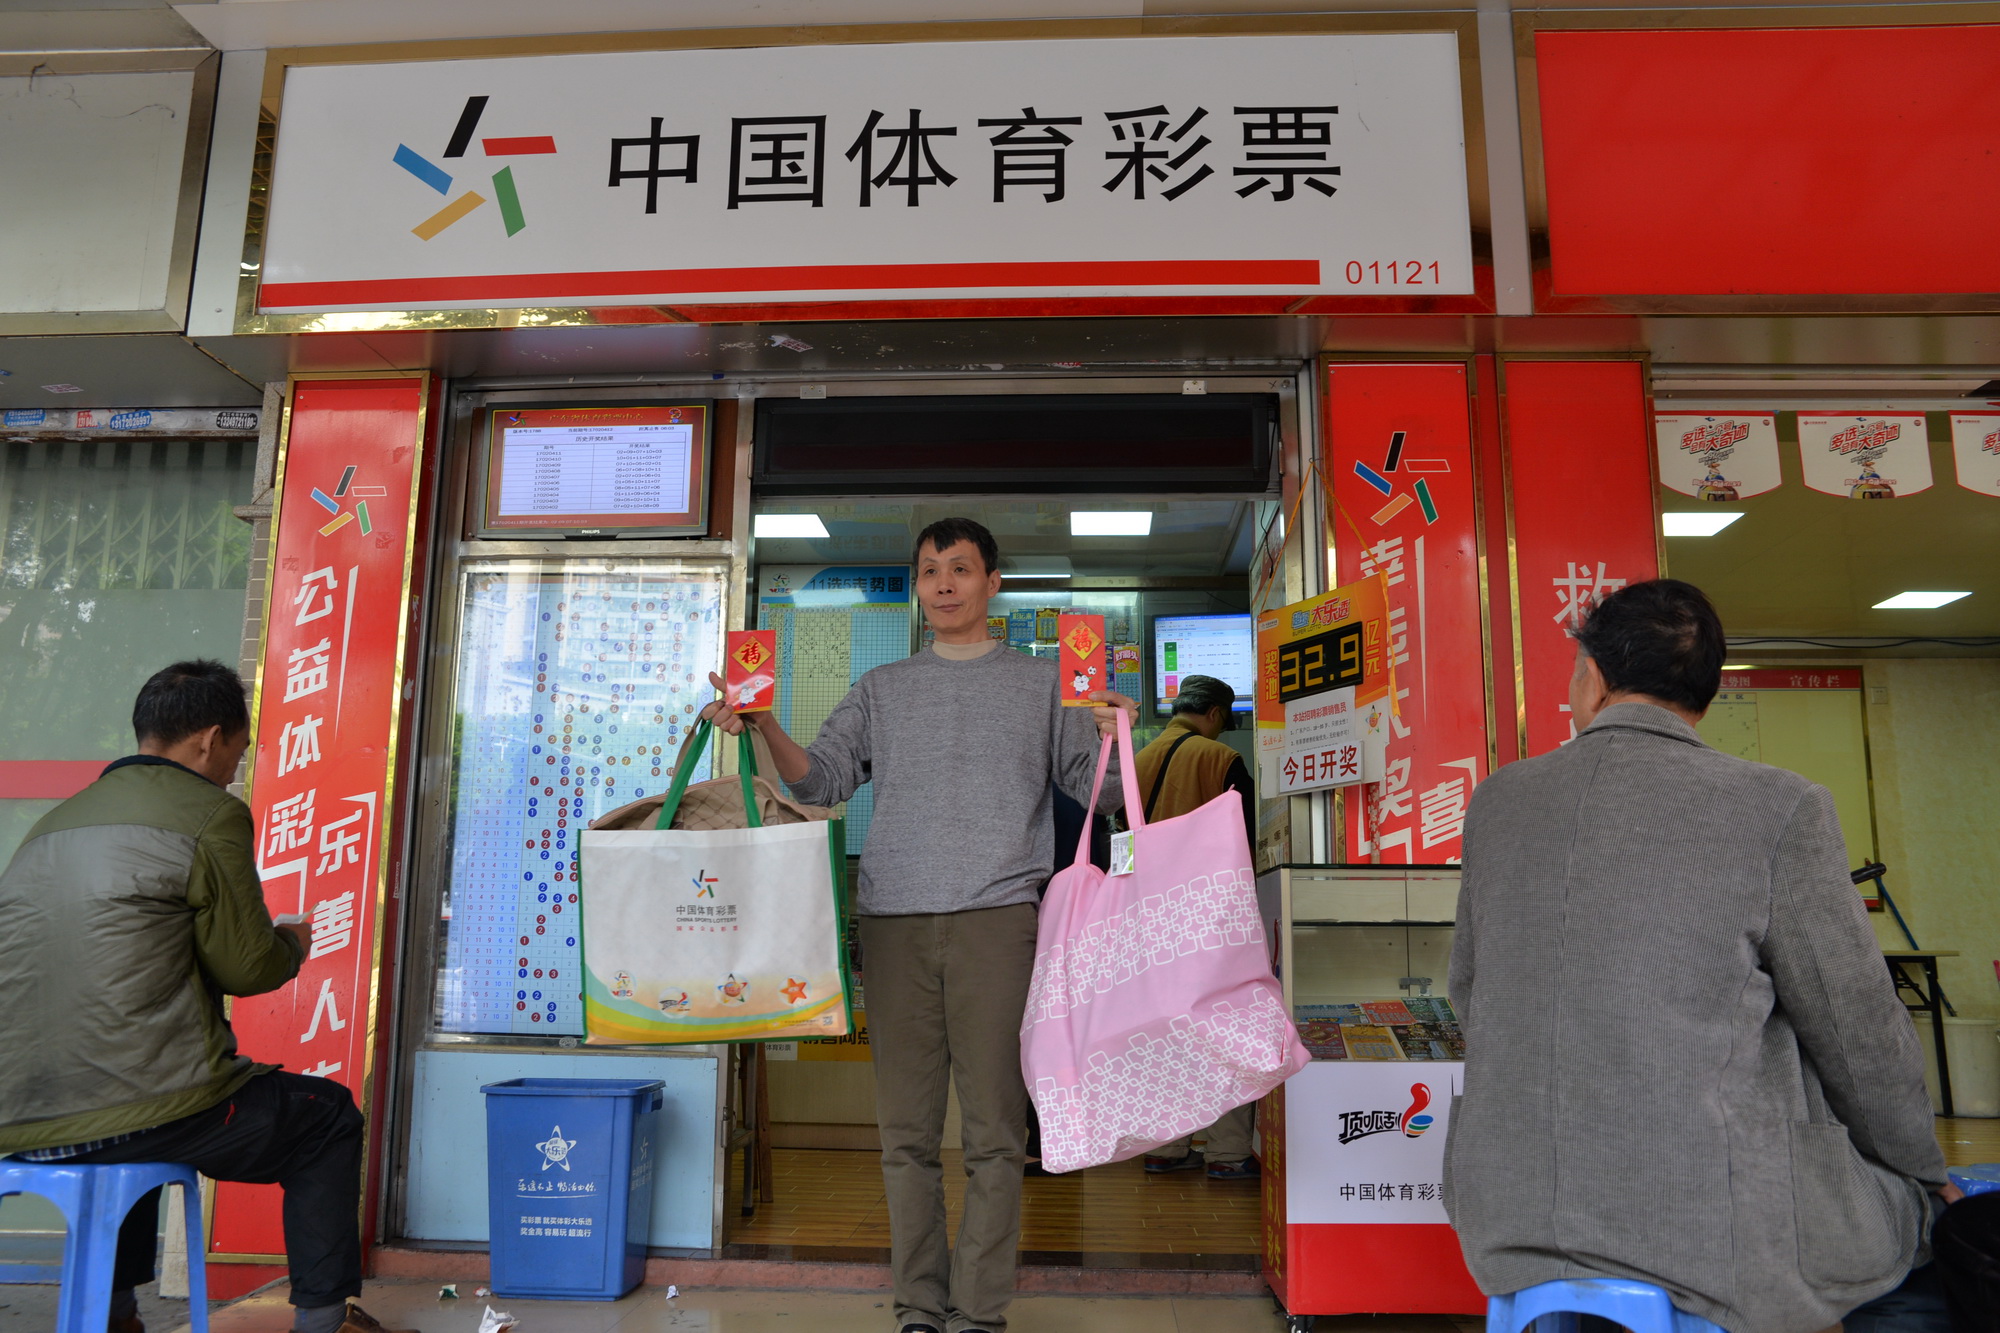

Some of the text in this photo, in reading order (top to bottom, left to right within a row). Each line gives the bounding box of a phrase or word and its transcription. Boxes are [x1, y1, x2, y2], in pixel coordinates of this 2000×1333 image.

[607, 105, 1342, 215] 中国体育彩票
[1345, 261, 1441, 286] 01121
[1691, 423, 1748, 453] 会有大奇迹
[1842, 424, 1899, 453] 会有大奇迹
[810, 576, 904, 593] 11选5走势图
[1072, 627, 1093, 653] 福
[1293, 629, 1307, 637] SUPER
[740, 641, 761, 666] 福
[1365, 617, 1381, 678] 亿元
[1264, 648, 1279, 702] 奖池
[1281, 633, 1360, 693] 32.9
[1789, 675, 1840, 688] 宣传栏
[267, 565, 338, 858] 公益体彩
[1293, 701, 1347, 723] 本站招聘彩票销售员
[1283, 745, 1358, 786] 今日开奖
[1420, 777, 1466, 864] 喜
[676, 905, 737, 916] 中国体育彩票
[1338, 1110, 1402, 1140] 顶呱刮
[520, 1216, 593, 1226] 买彩票 就买体彩大乐透
[520, 1227, 592, 1238] 奖金高 容易玩 超流行
